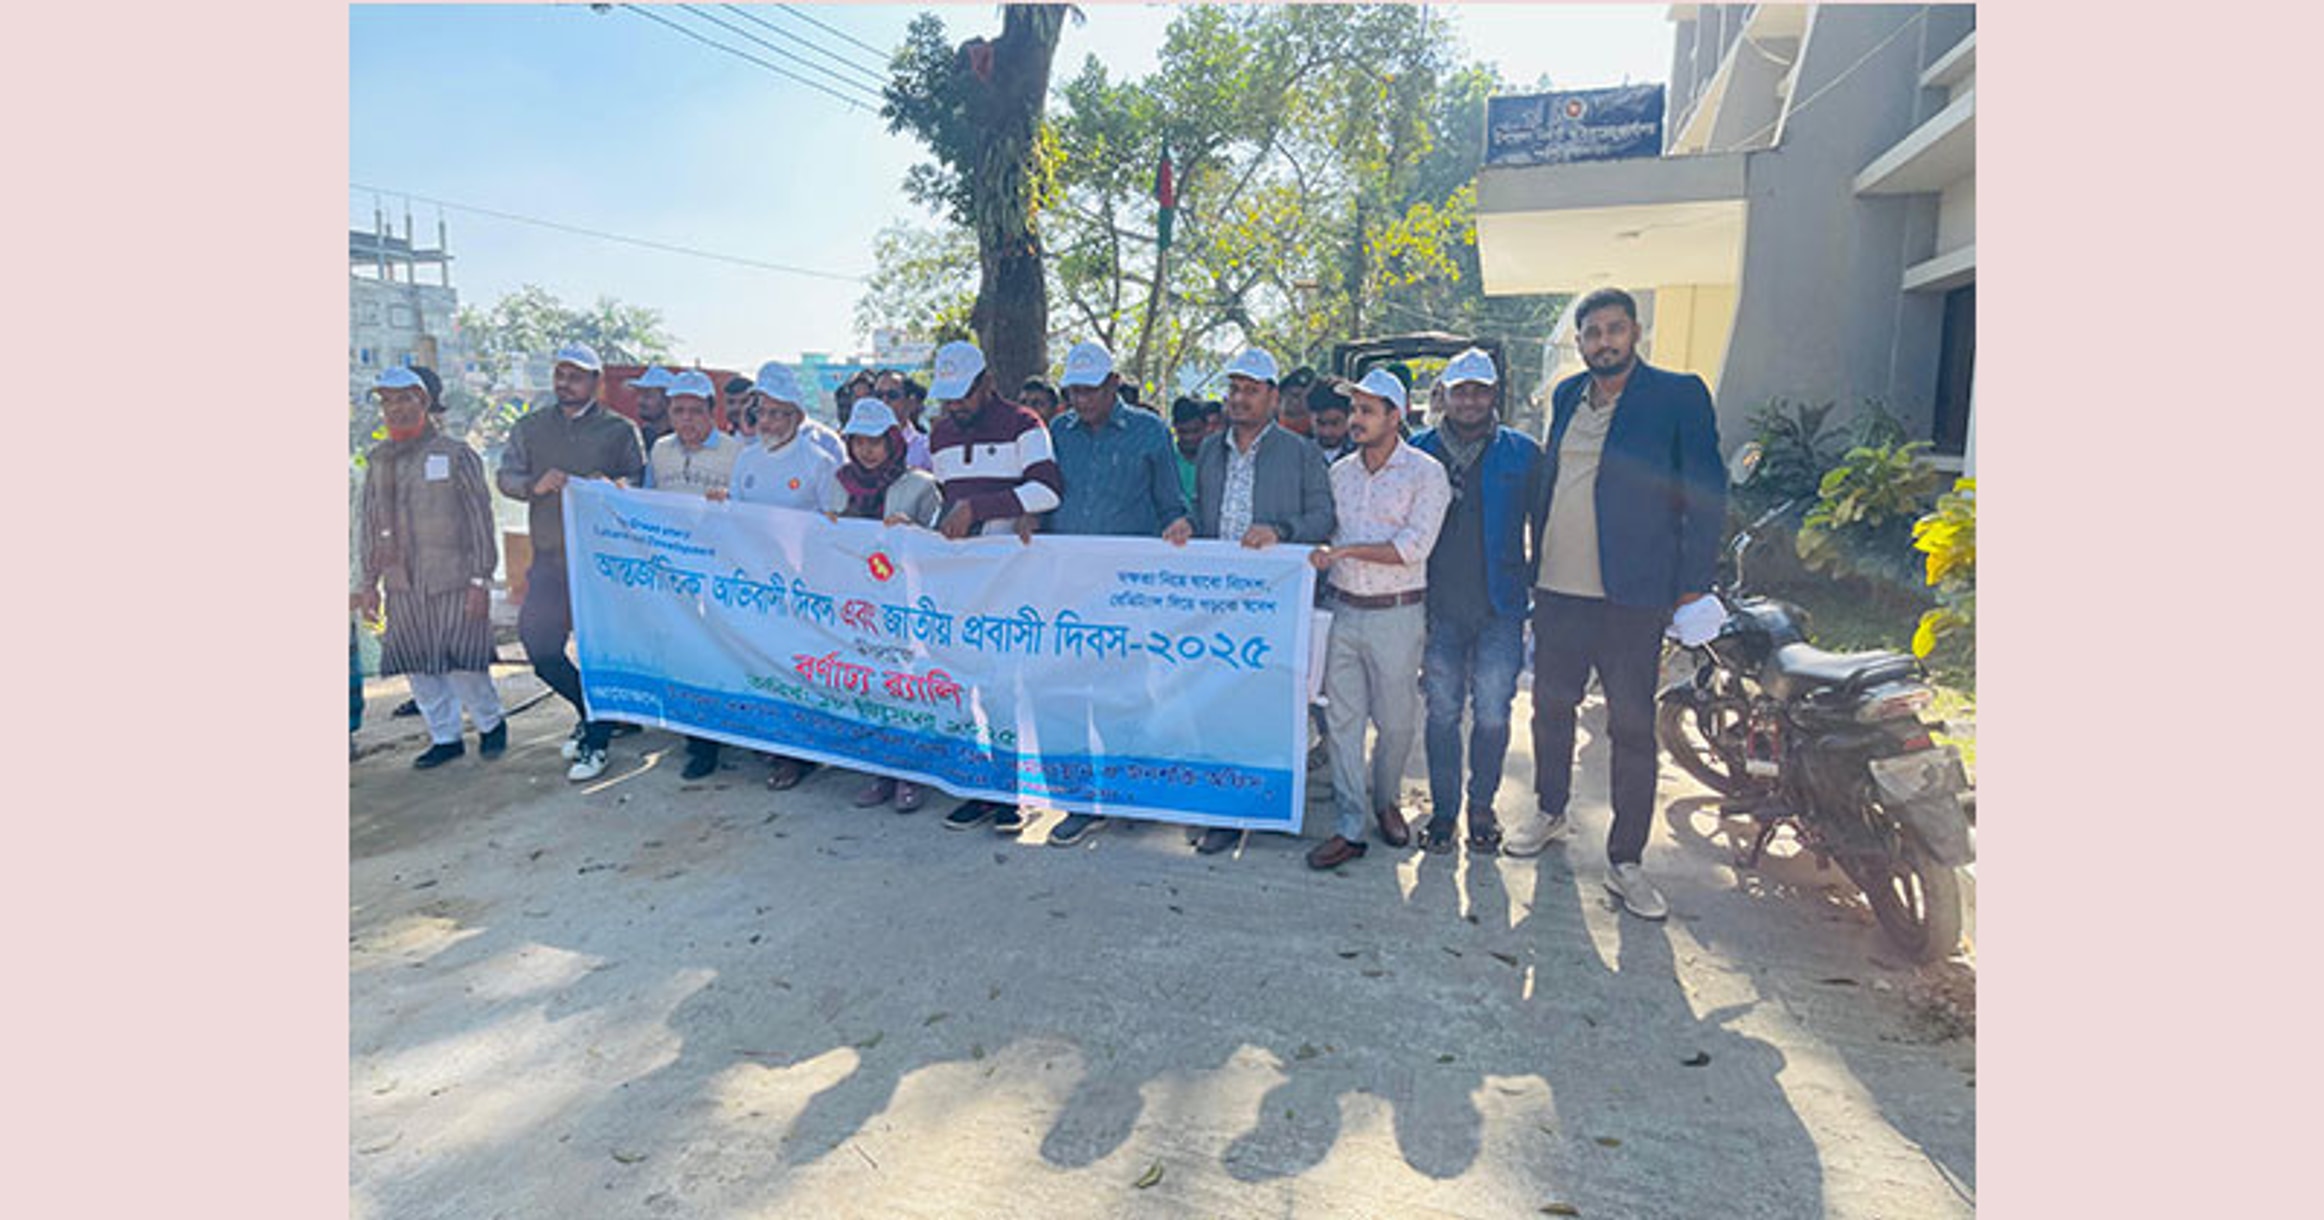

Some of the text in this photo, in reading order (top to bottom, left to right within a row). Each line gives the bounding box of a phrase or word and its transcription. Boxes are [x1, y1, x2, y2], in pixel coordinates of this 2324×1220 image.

[594, 551, 1272, 670] আন্তর্জাতিক অভিবাসী দিবস এবং জাতীয় প্রবাসী দিবস-২০২৫
[791, 650, 875, 696] বর্ণাঢ্য
